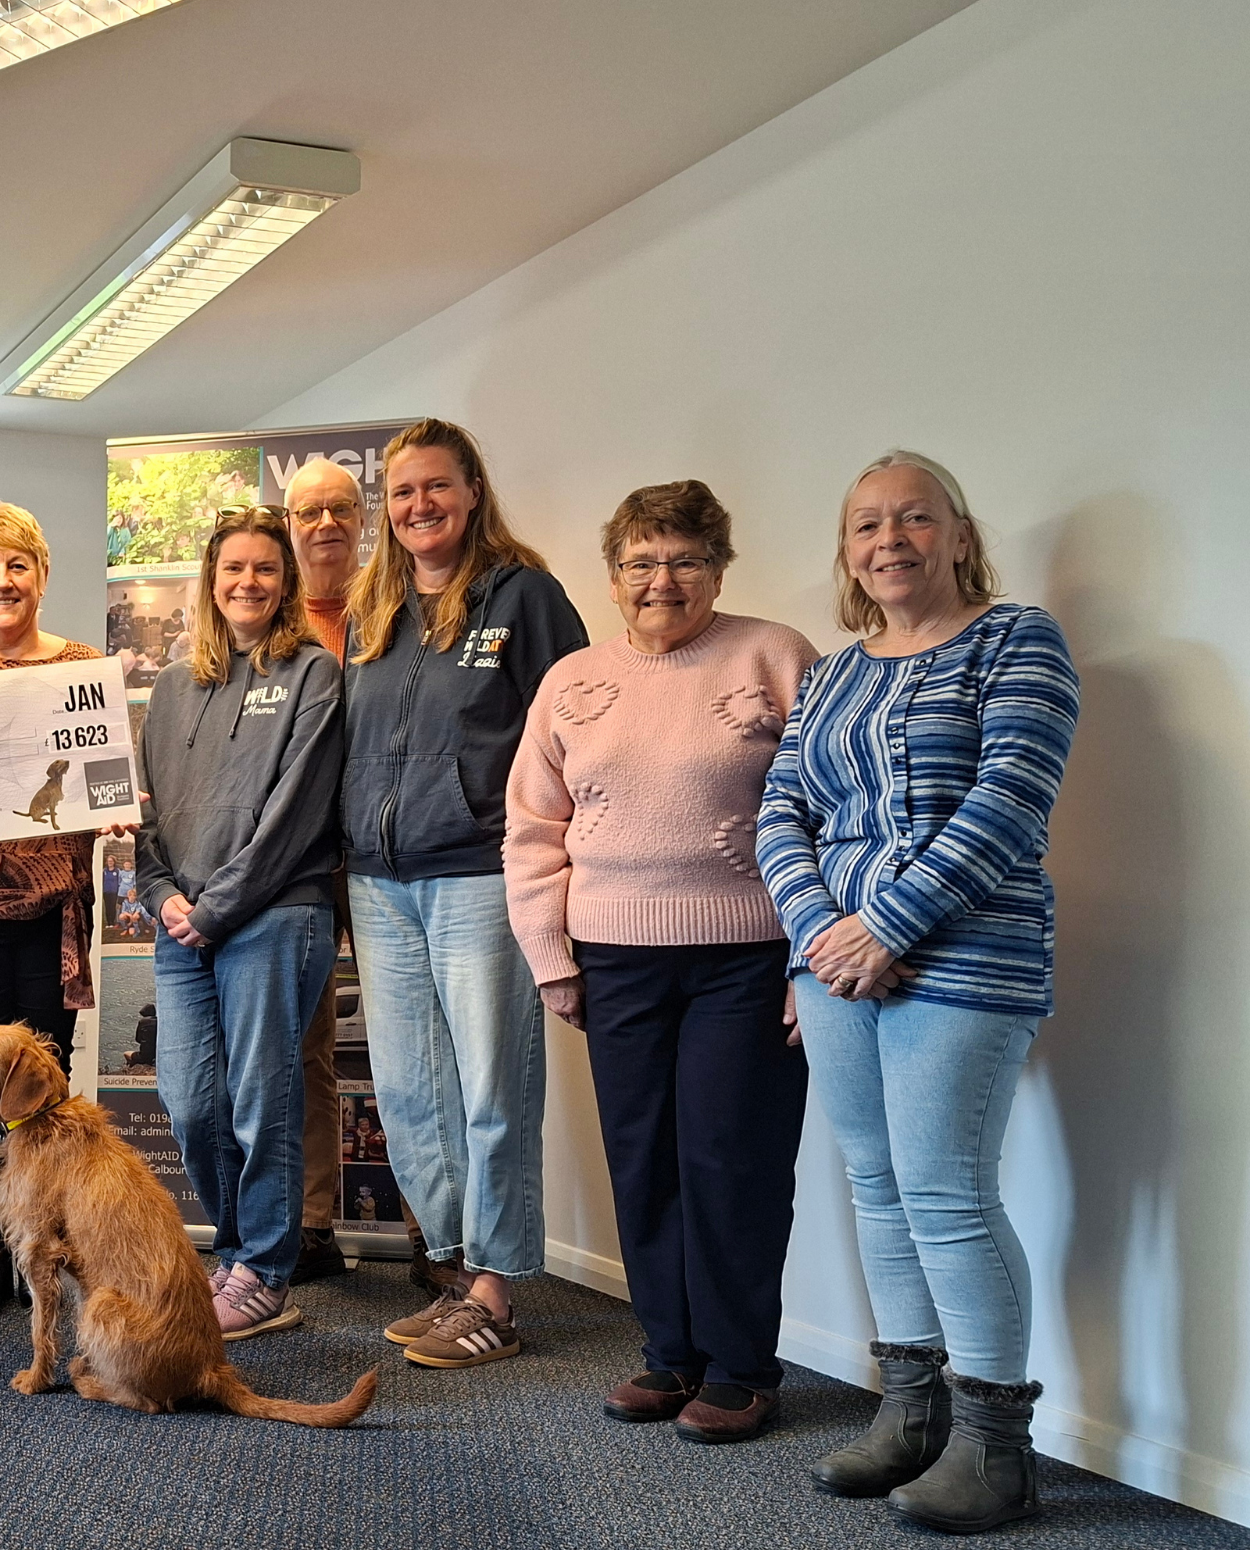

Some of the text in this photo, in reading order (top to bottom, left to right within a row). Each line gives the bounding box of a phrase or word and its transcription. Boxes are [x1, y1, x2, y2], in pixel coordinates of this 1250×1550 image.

[365, 492, 378, 501] The
[150, 564, 180, 573] Shanklin
[64, 682, 106, 712] JAN
[242, 704, 277, 717] Mama
[90, 782, 129, 798] WIGHT
[130, 945, 148, 954] Ryde
[104, 1077, 130, 1086] Suicide
[338, 1082, 360, 1092] Lamp
[129, 1113, 146, 1123] Tel:
[361, 1222, 380, 1231] Club
